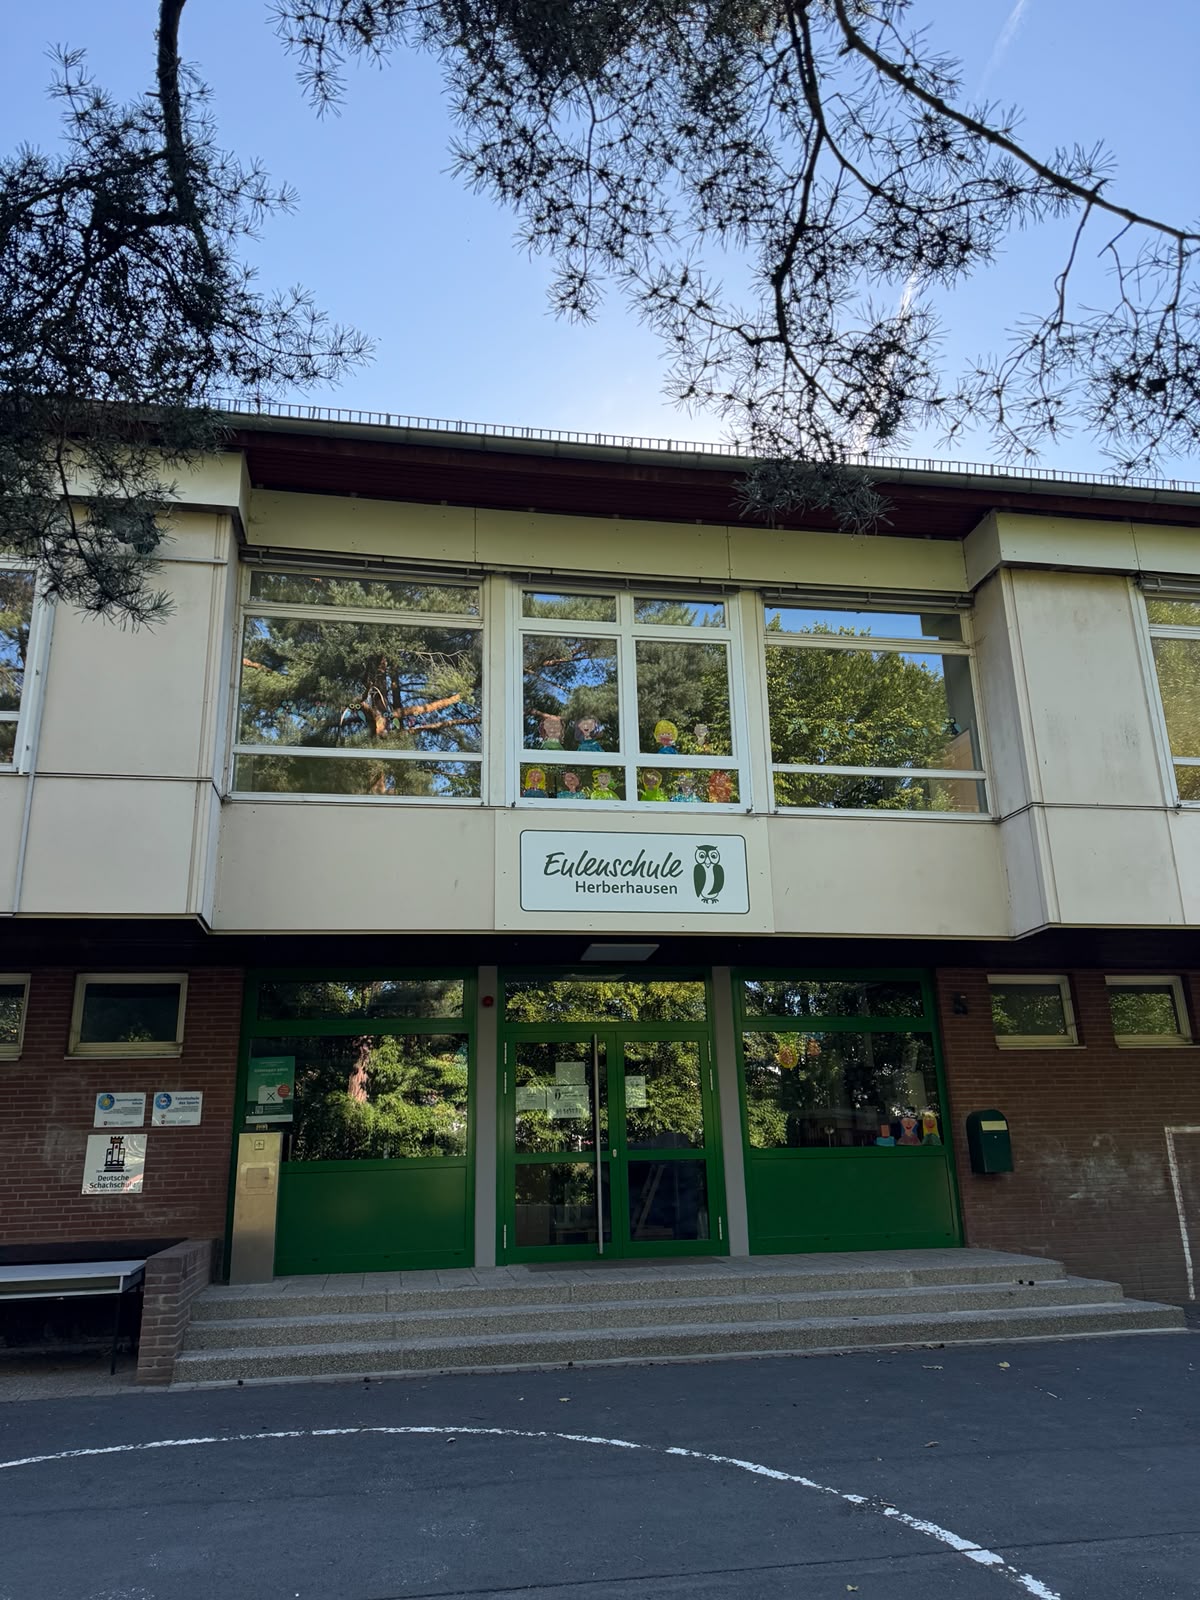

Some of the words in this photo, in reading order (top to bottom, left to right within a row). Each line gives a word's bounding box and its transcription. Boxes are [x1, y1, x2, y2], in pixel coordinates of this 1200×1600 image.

[543, 849, 684, 879] Eulenschule
[575, 881, 678, 895] Herberhausen
[97, 1174, 130, 1182] Deutsche
[89, 1181, 136, 1189] Schachschule
